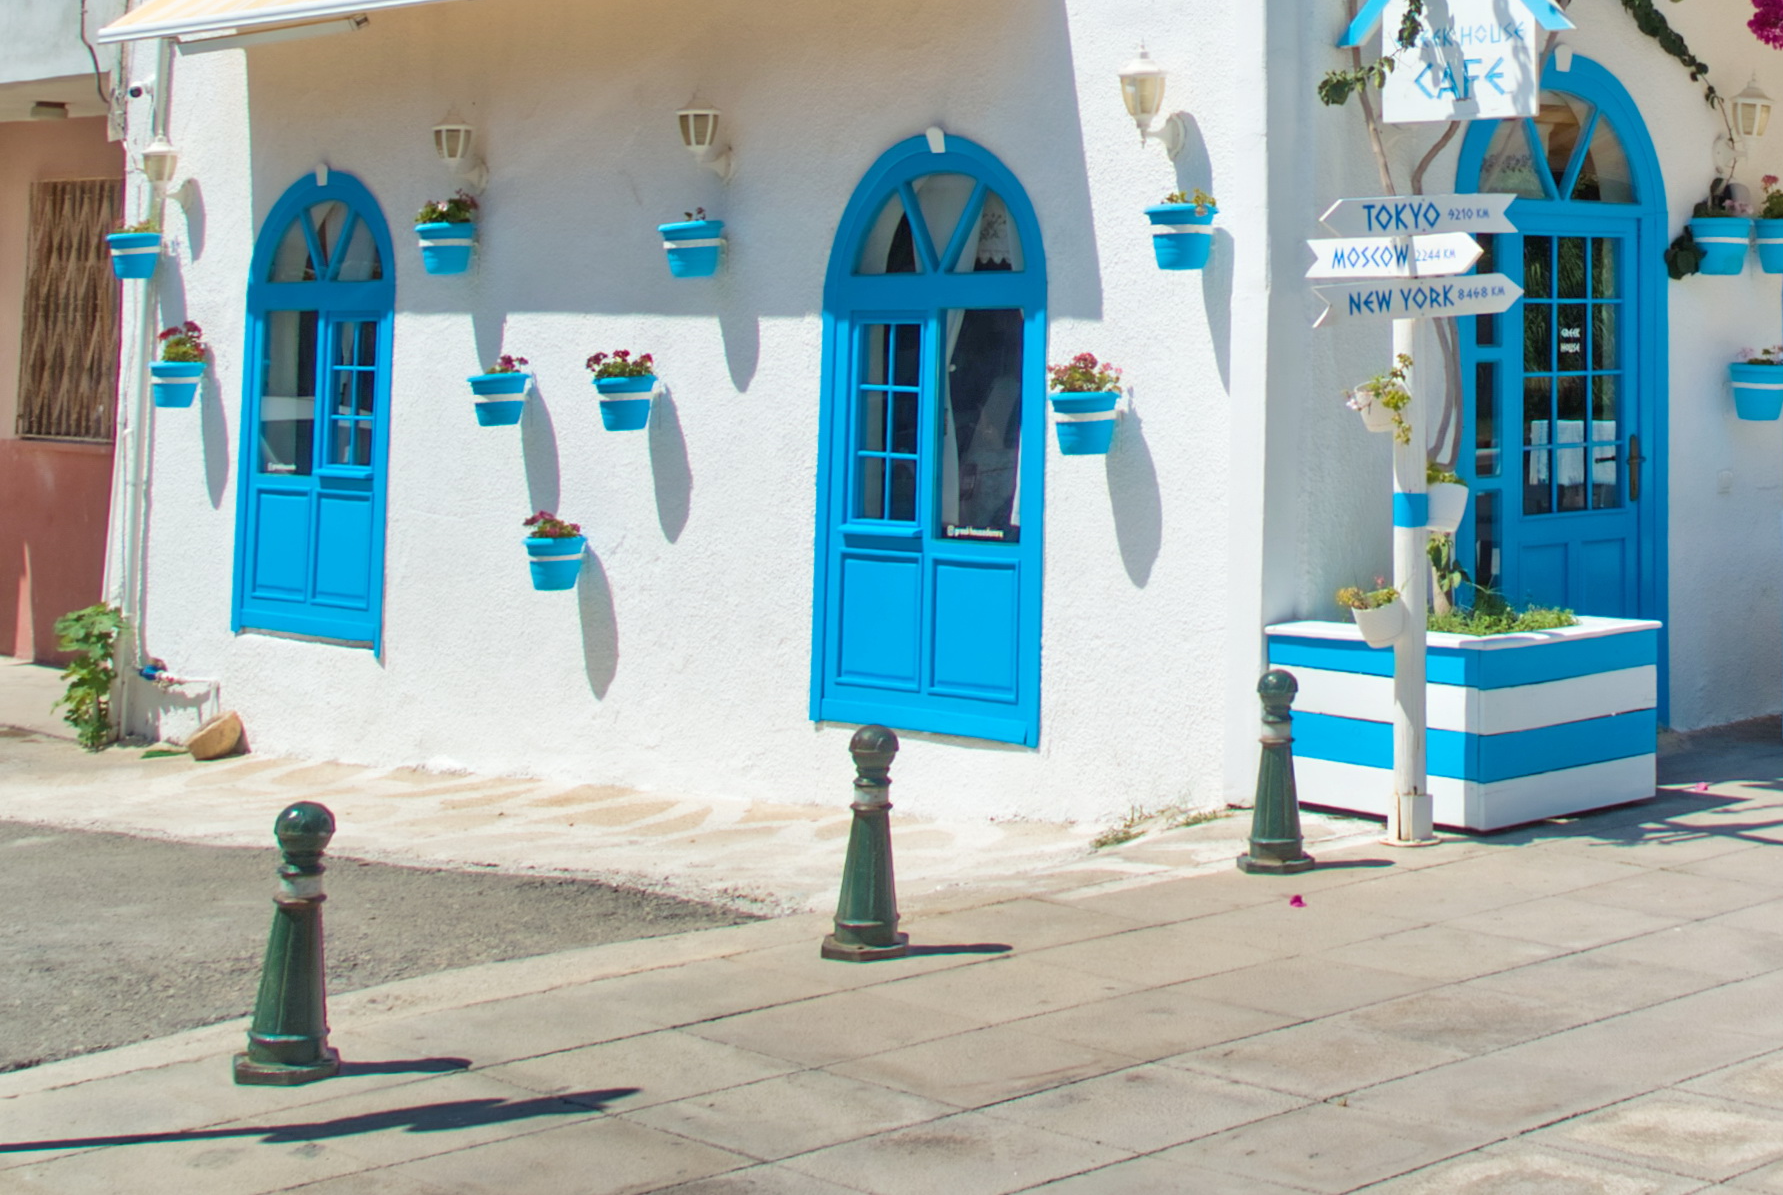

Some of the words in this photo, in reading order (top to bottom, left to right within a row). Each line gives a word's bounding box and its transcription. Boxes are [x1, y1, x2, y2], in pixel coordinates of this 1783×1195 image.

[1461, 21, 1525, 45] HOUSE
[1414, 57, 1505, 99] CAFE
[1362, 202, 1441, 231] TOKYO
[1448, 208, 1473, 221] 9210
[1476, 208, 1490, 219] KM
[1331, 244, 1409, 269] MOSCOW
[1415, 248, 1441, 262] 2244
[1443, 248, 1456, 259] KM
[1349, 288, 1392, 316] NEW
[1400, 284, 1454, 311] YORK
[1458, 285, 1488, 300] 8468
[1491, 286, 1505, 296] KM
